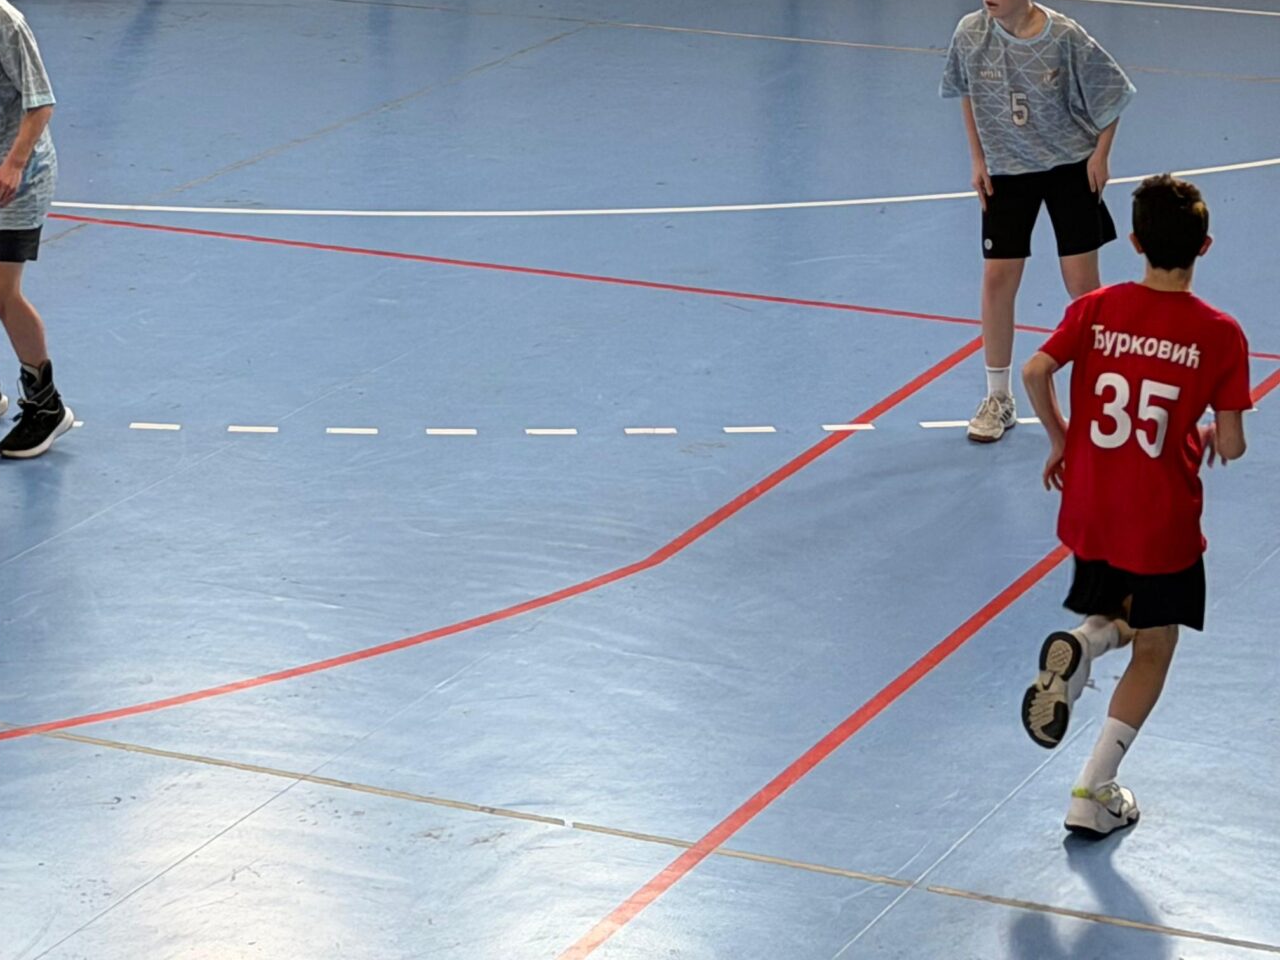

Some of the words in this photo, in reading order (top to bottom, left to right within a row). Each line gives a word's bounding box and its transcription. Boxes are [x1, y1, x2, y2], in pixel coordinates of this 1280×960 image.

[1011, 92, 1029, 127] 5
[1091, 324, 1201, 370] Ђурковић
[1090, 372, 1181, 458] 35
